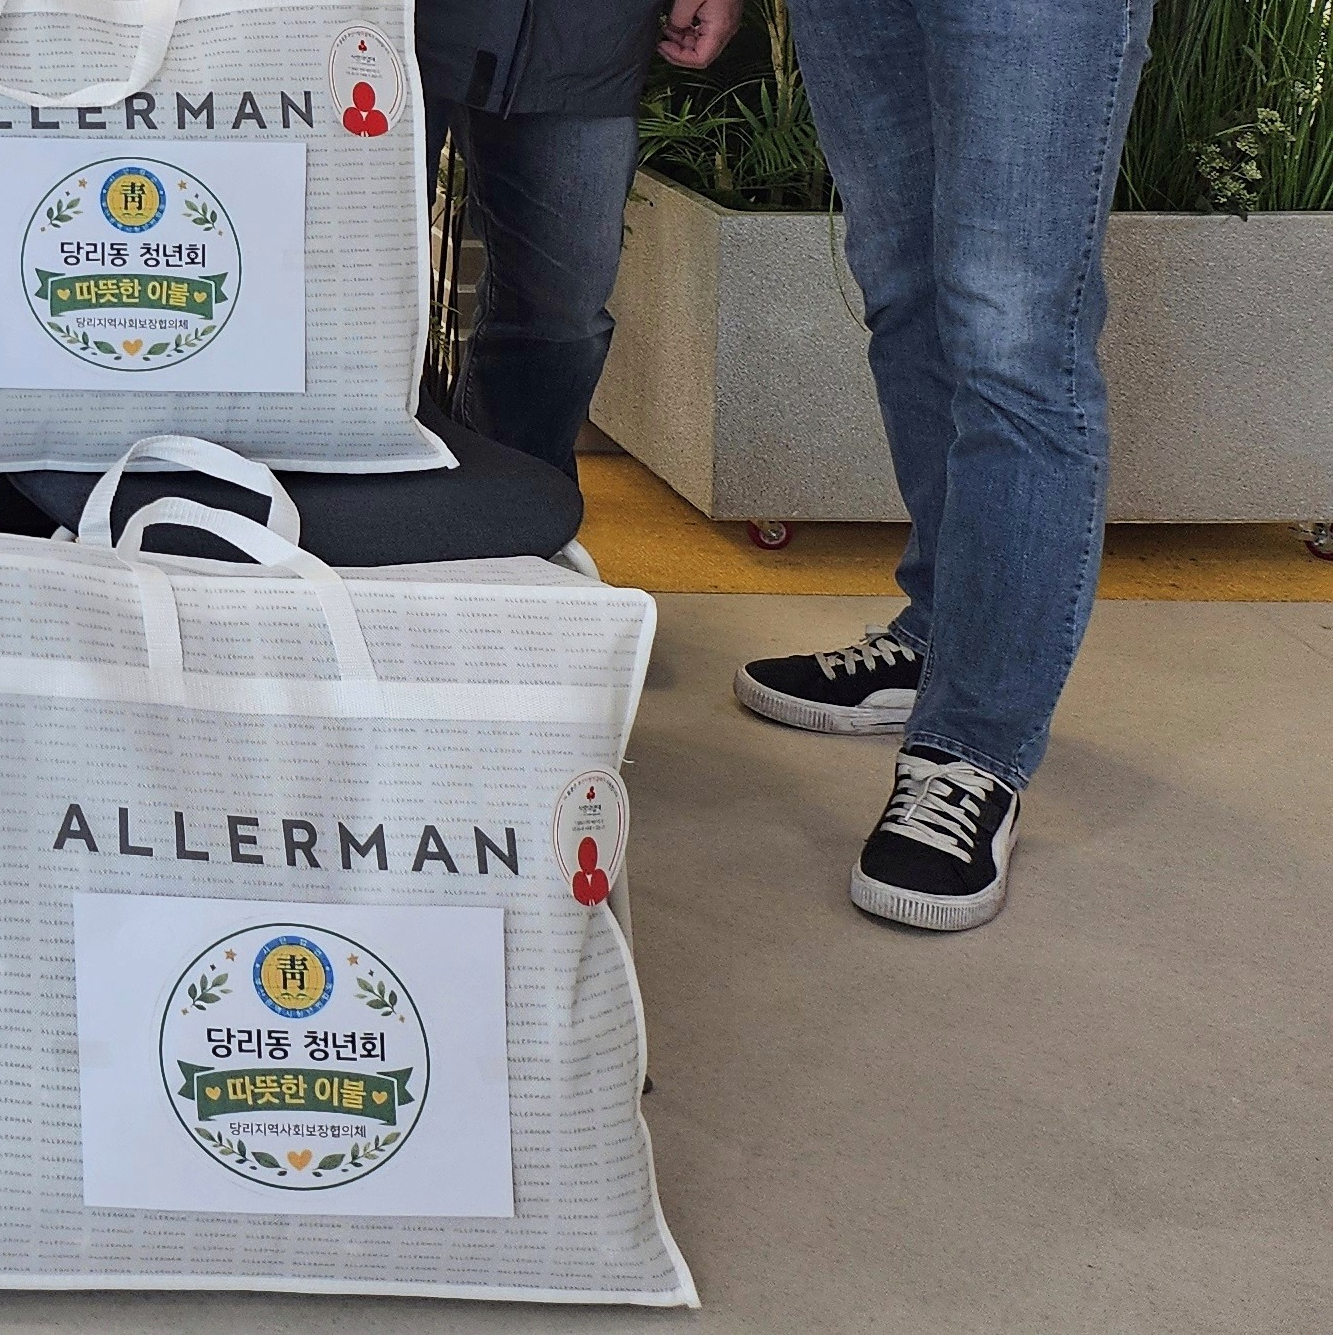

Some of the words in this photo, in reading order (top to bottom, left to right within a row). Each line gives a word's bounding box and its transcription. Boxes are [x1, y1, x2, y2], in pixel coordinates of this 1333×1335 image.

[60, 240, 130, 268] 당리동
[139, 242, 206, 268] 청년회
[76, 279, 141, 303] 따뜻한
[148, 281, 189, 306] 이불
[53, 804, 519, 875] ALLERMAN
[206, 1027, 292, 1061] 당리동
[303, 1030, 386, 1062] 청년회
[227, 1075, 307, 1105] 따뜻한
[315, 1078, 366, 1108] 이불
[229, 1121, 367, 1139] 당리지역사회보장협의체
